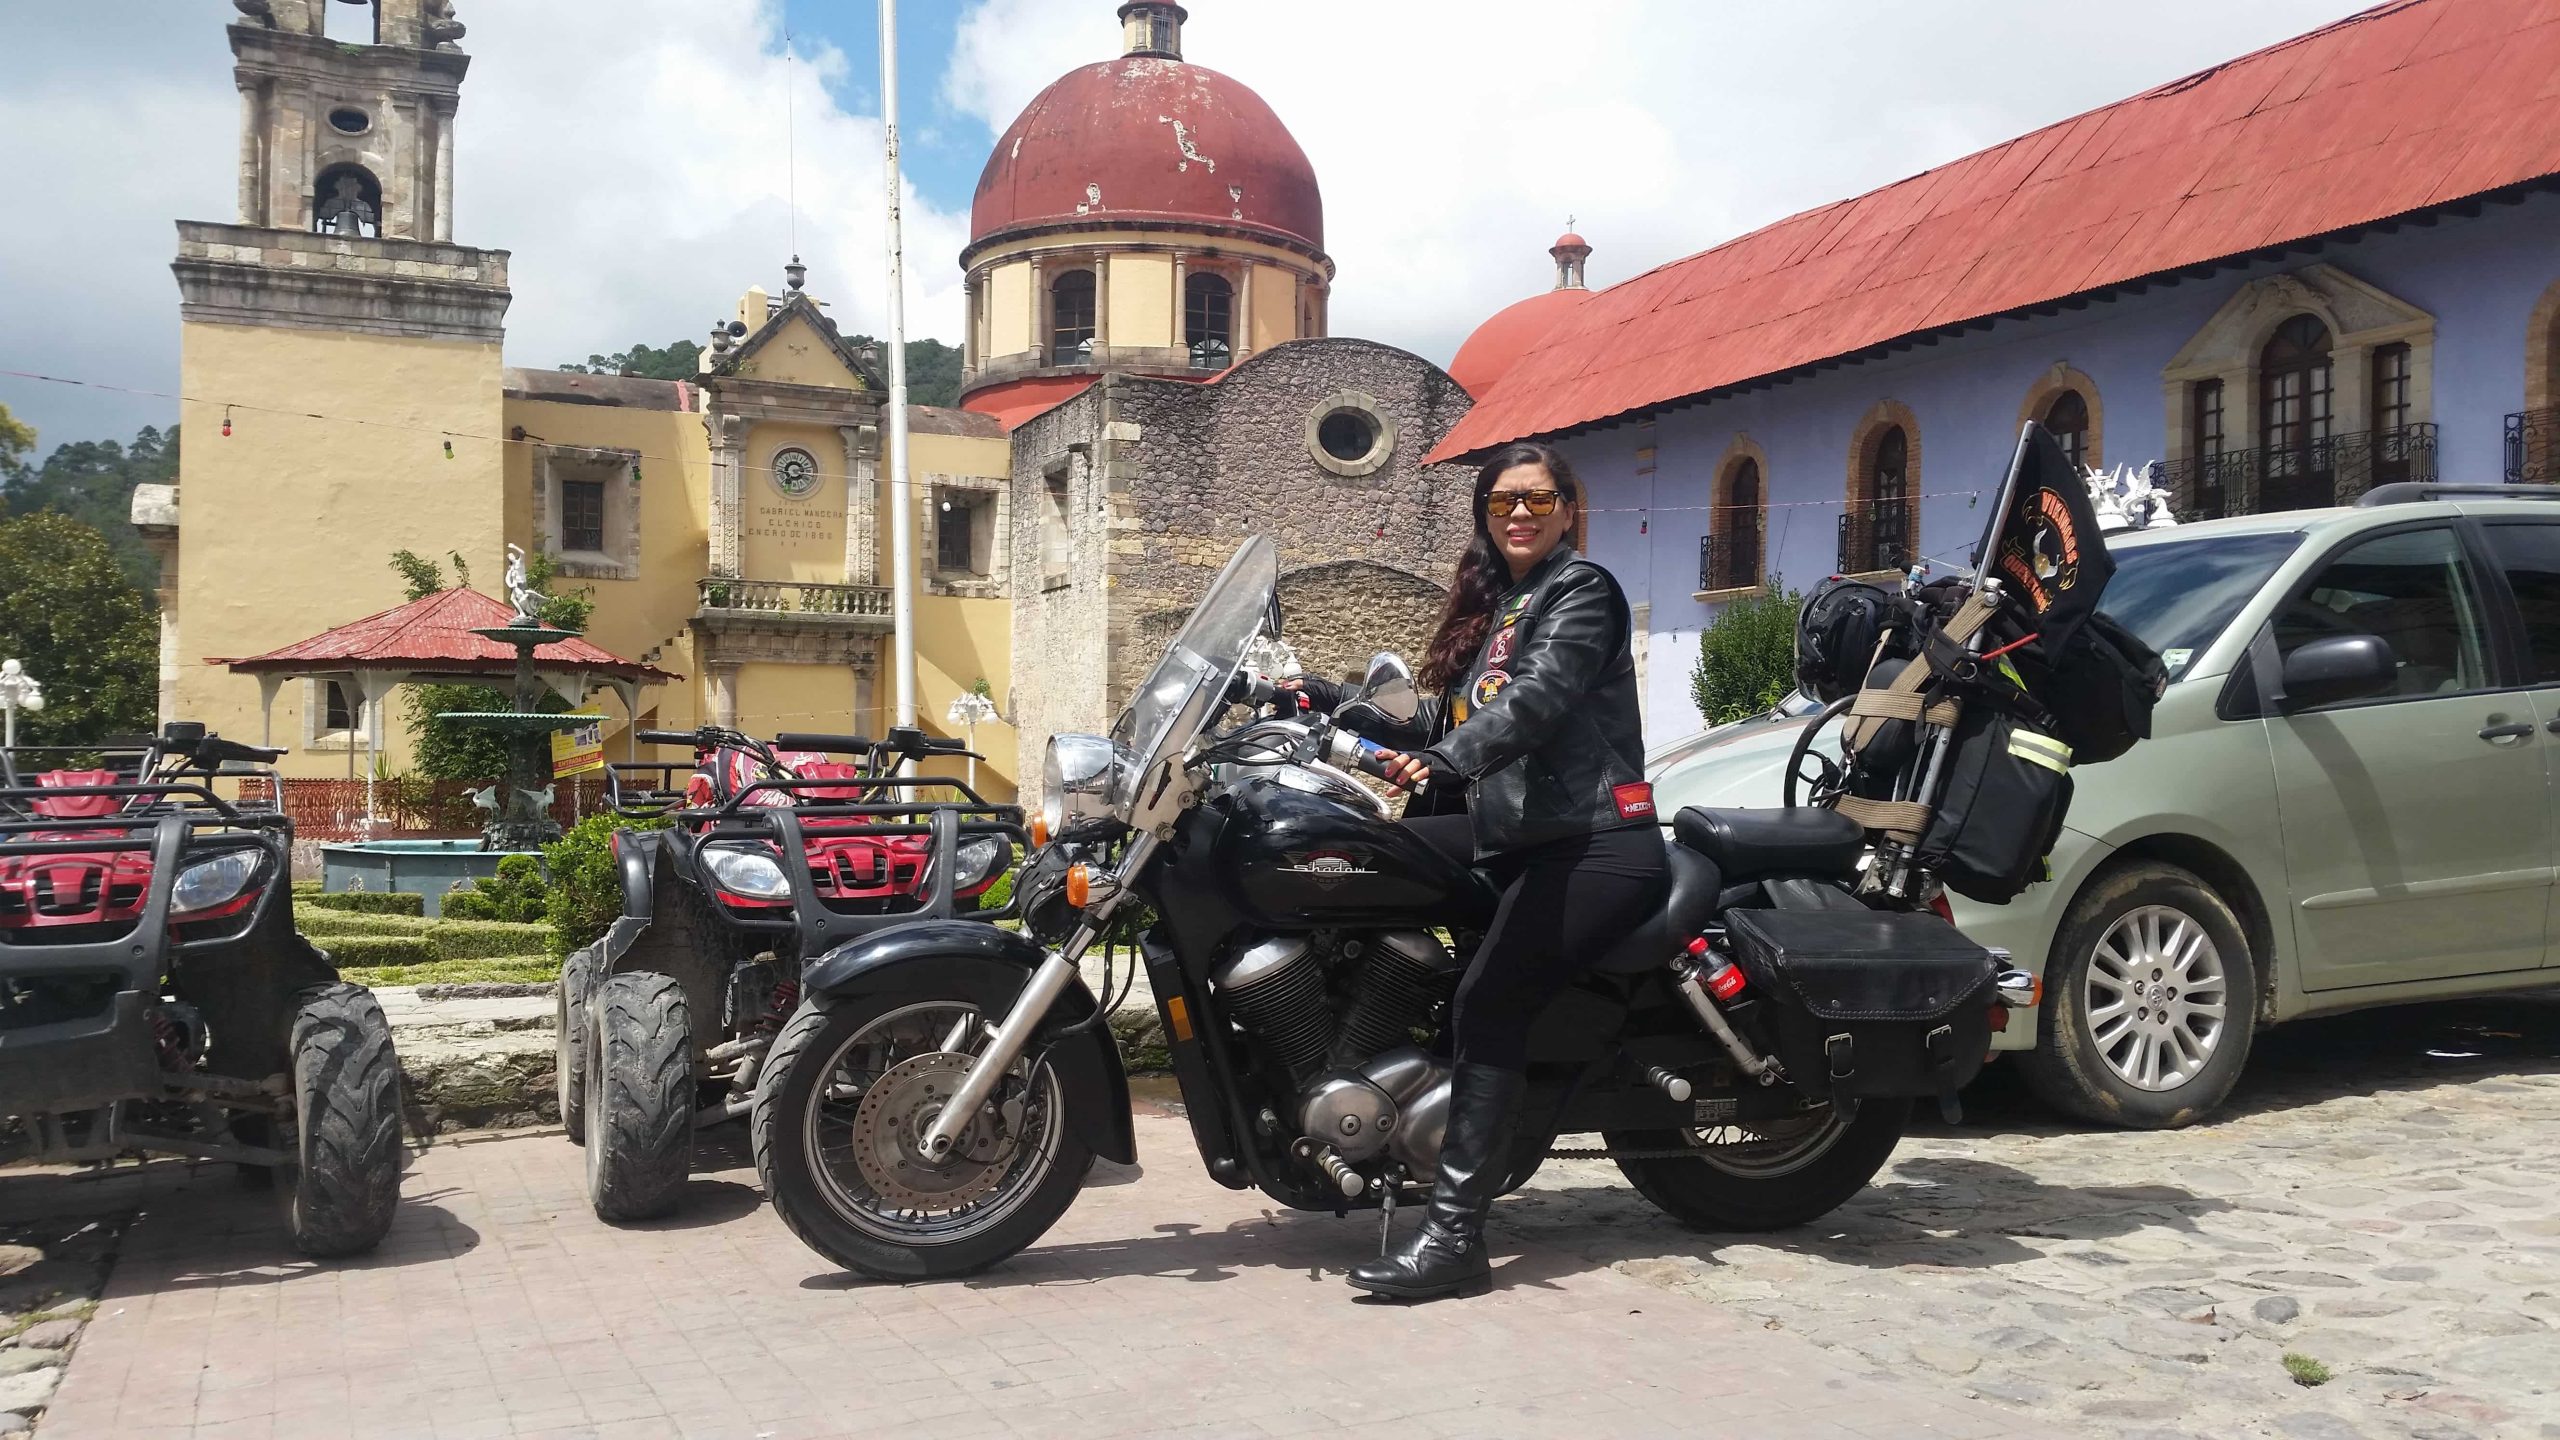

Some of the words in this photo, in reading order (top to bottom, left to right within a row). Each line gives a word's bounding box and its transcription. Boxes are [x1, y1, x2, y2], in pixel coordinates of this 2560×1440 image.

[760, 507, 800, 516] GABRIEL
[748, 528, 786, 537] ENERO
[790, 530, 801, 538] DE
[2041, 491, 2079, 565] VIKINGOS
[1286, 859, 1371, 874] Shadow
